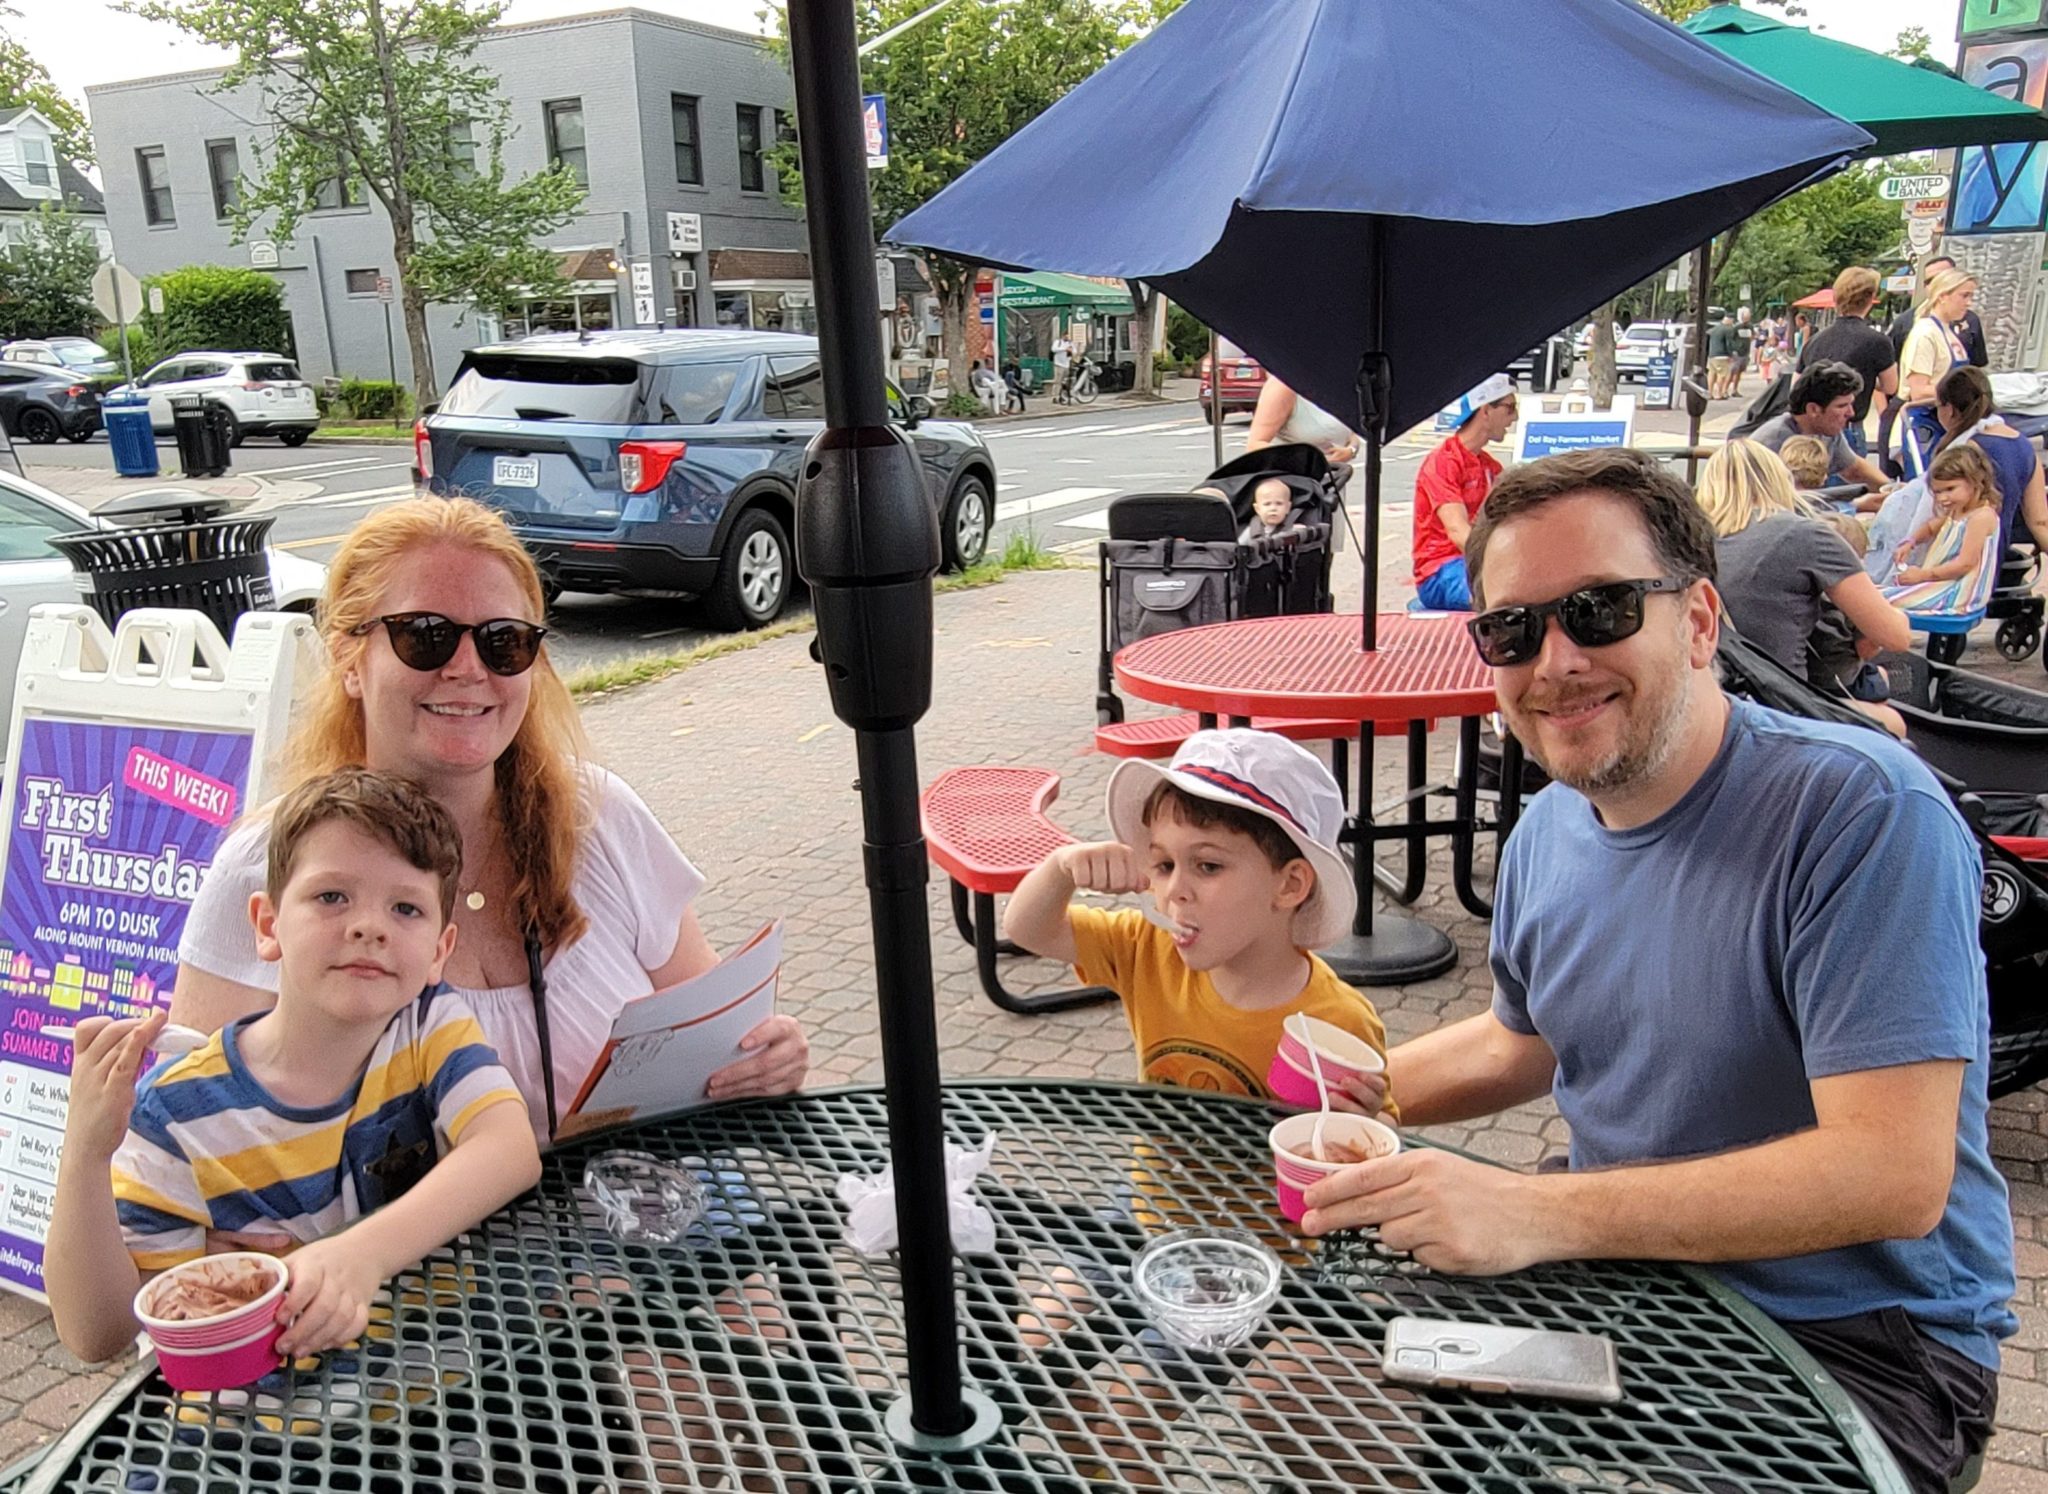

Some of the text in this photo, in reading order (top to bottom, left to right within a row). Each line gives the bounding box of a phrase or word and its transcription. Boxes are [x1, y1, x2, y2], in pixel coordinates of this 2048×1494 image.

[1899, 187, 1932, 197] BANK
[1900, 177, 1943, 188] UNITED
[1590, 435, 1620, 443] Market
[133, 754, 229, 816] THIS WEEK!
[22, 780, 112, 834] First
[60, 902, 161, 938] 6PM TO DUSK
[34, 925, 67, 944] ALONG
[68, 932, 104, 950] MOUNT
[106, 937, 147, 957] VERNON
[11, 1008, 46, 1031] JOIN
[2, 1031, 58, 1063] SUMMER
[4, 1087, 12, 1104] 6
[21, 1135, 34, 1150] Del
[29, 1188, 48, 1205] Wars
